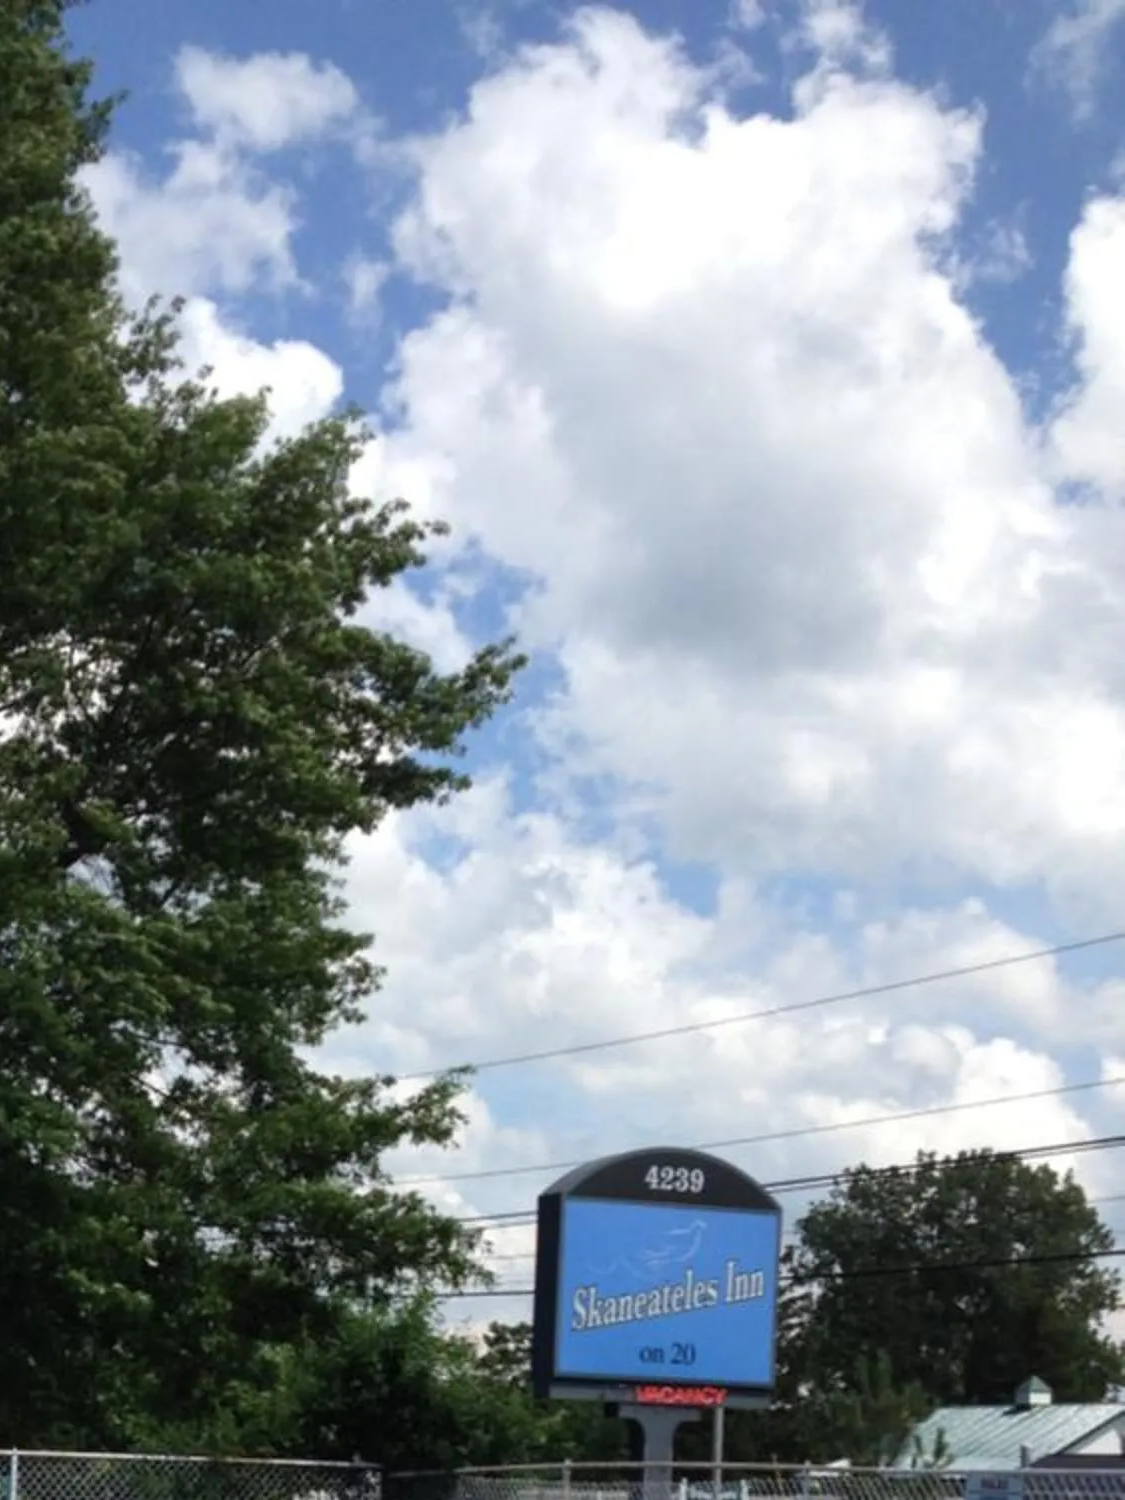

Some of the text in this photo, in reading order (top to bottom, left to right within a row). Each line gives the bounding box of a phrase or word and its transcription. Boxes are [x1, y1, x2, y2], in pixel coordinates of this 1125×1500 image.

[644, 1164, 705, 1193] 4239
[571, 1259, 765, 1331] Skaneateles Inn
[638, 1341, 697, 1366] on 20
